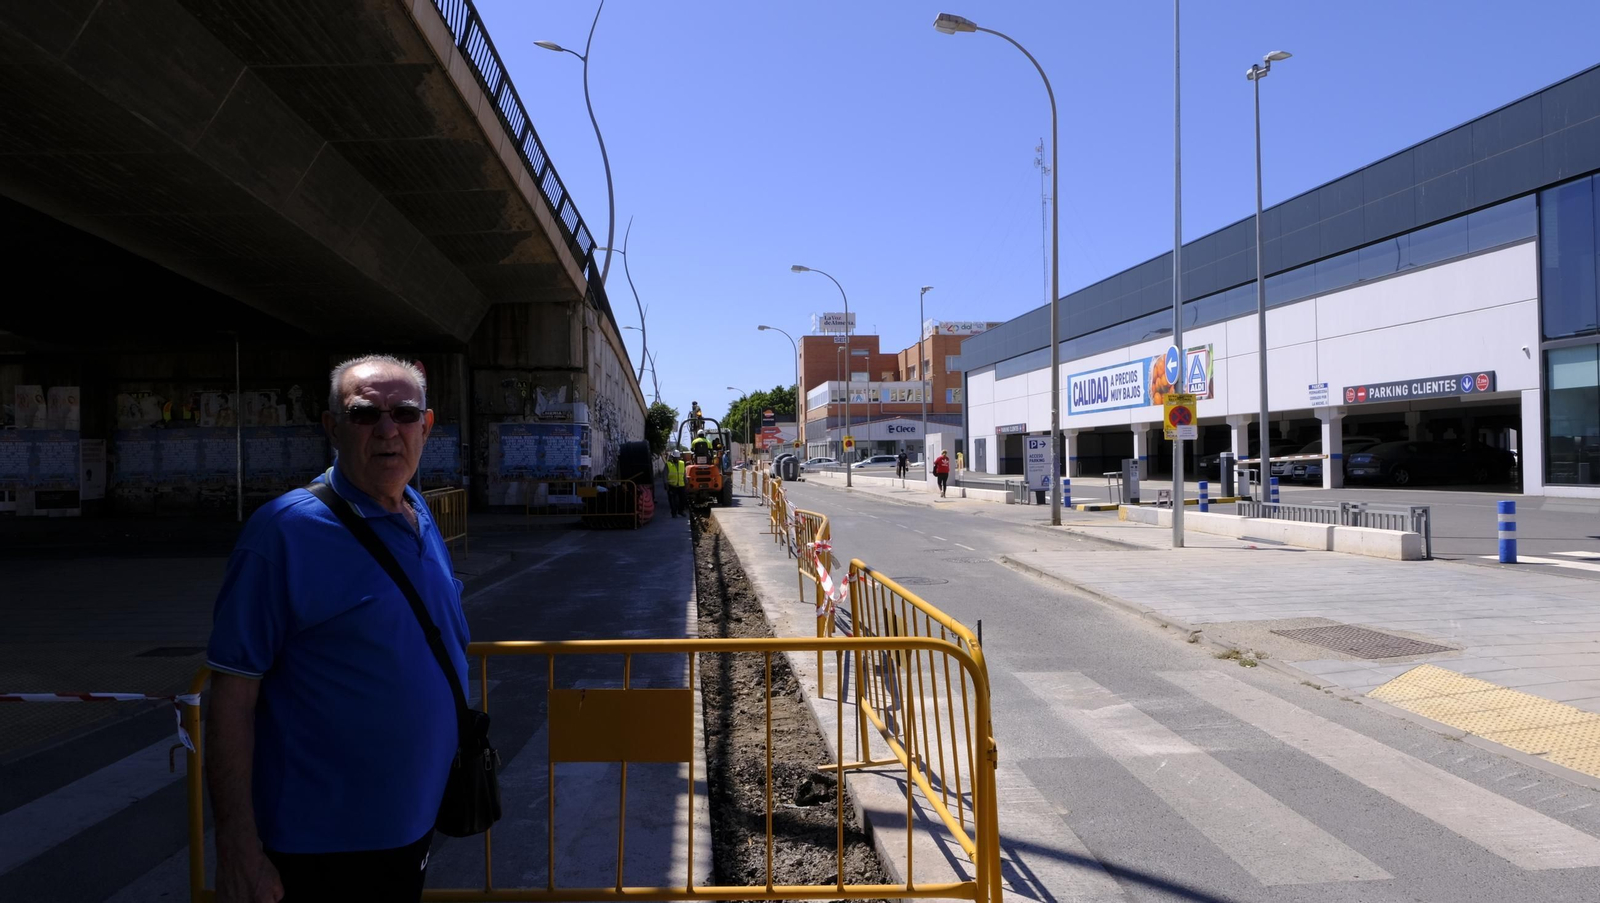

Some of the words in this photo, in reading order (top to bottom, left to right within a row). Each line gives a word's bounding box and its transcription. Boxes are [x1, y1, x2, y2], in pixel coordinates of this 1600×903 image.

[1110, 374, 1115, 387] A
[1115, 370, 1138, 386] PRECIOS
[1190, 383, 1205, 391] ALDI
[1073, 375, 1109, 407] CALIDAD
[1110, 388, 1122, 402] MUY
[1122, 385, 1141, 400] BAJOS
[1369, 382, 1409, 399] PARKING
[1412, 379, 1457, 395] CLIENTES
[895, 425, 916, 433] Clece
